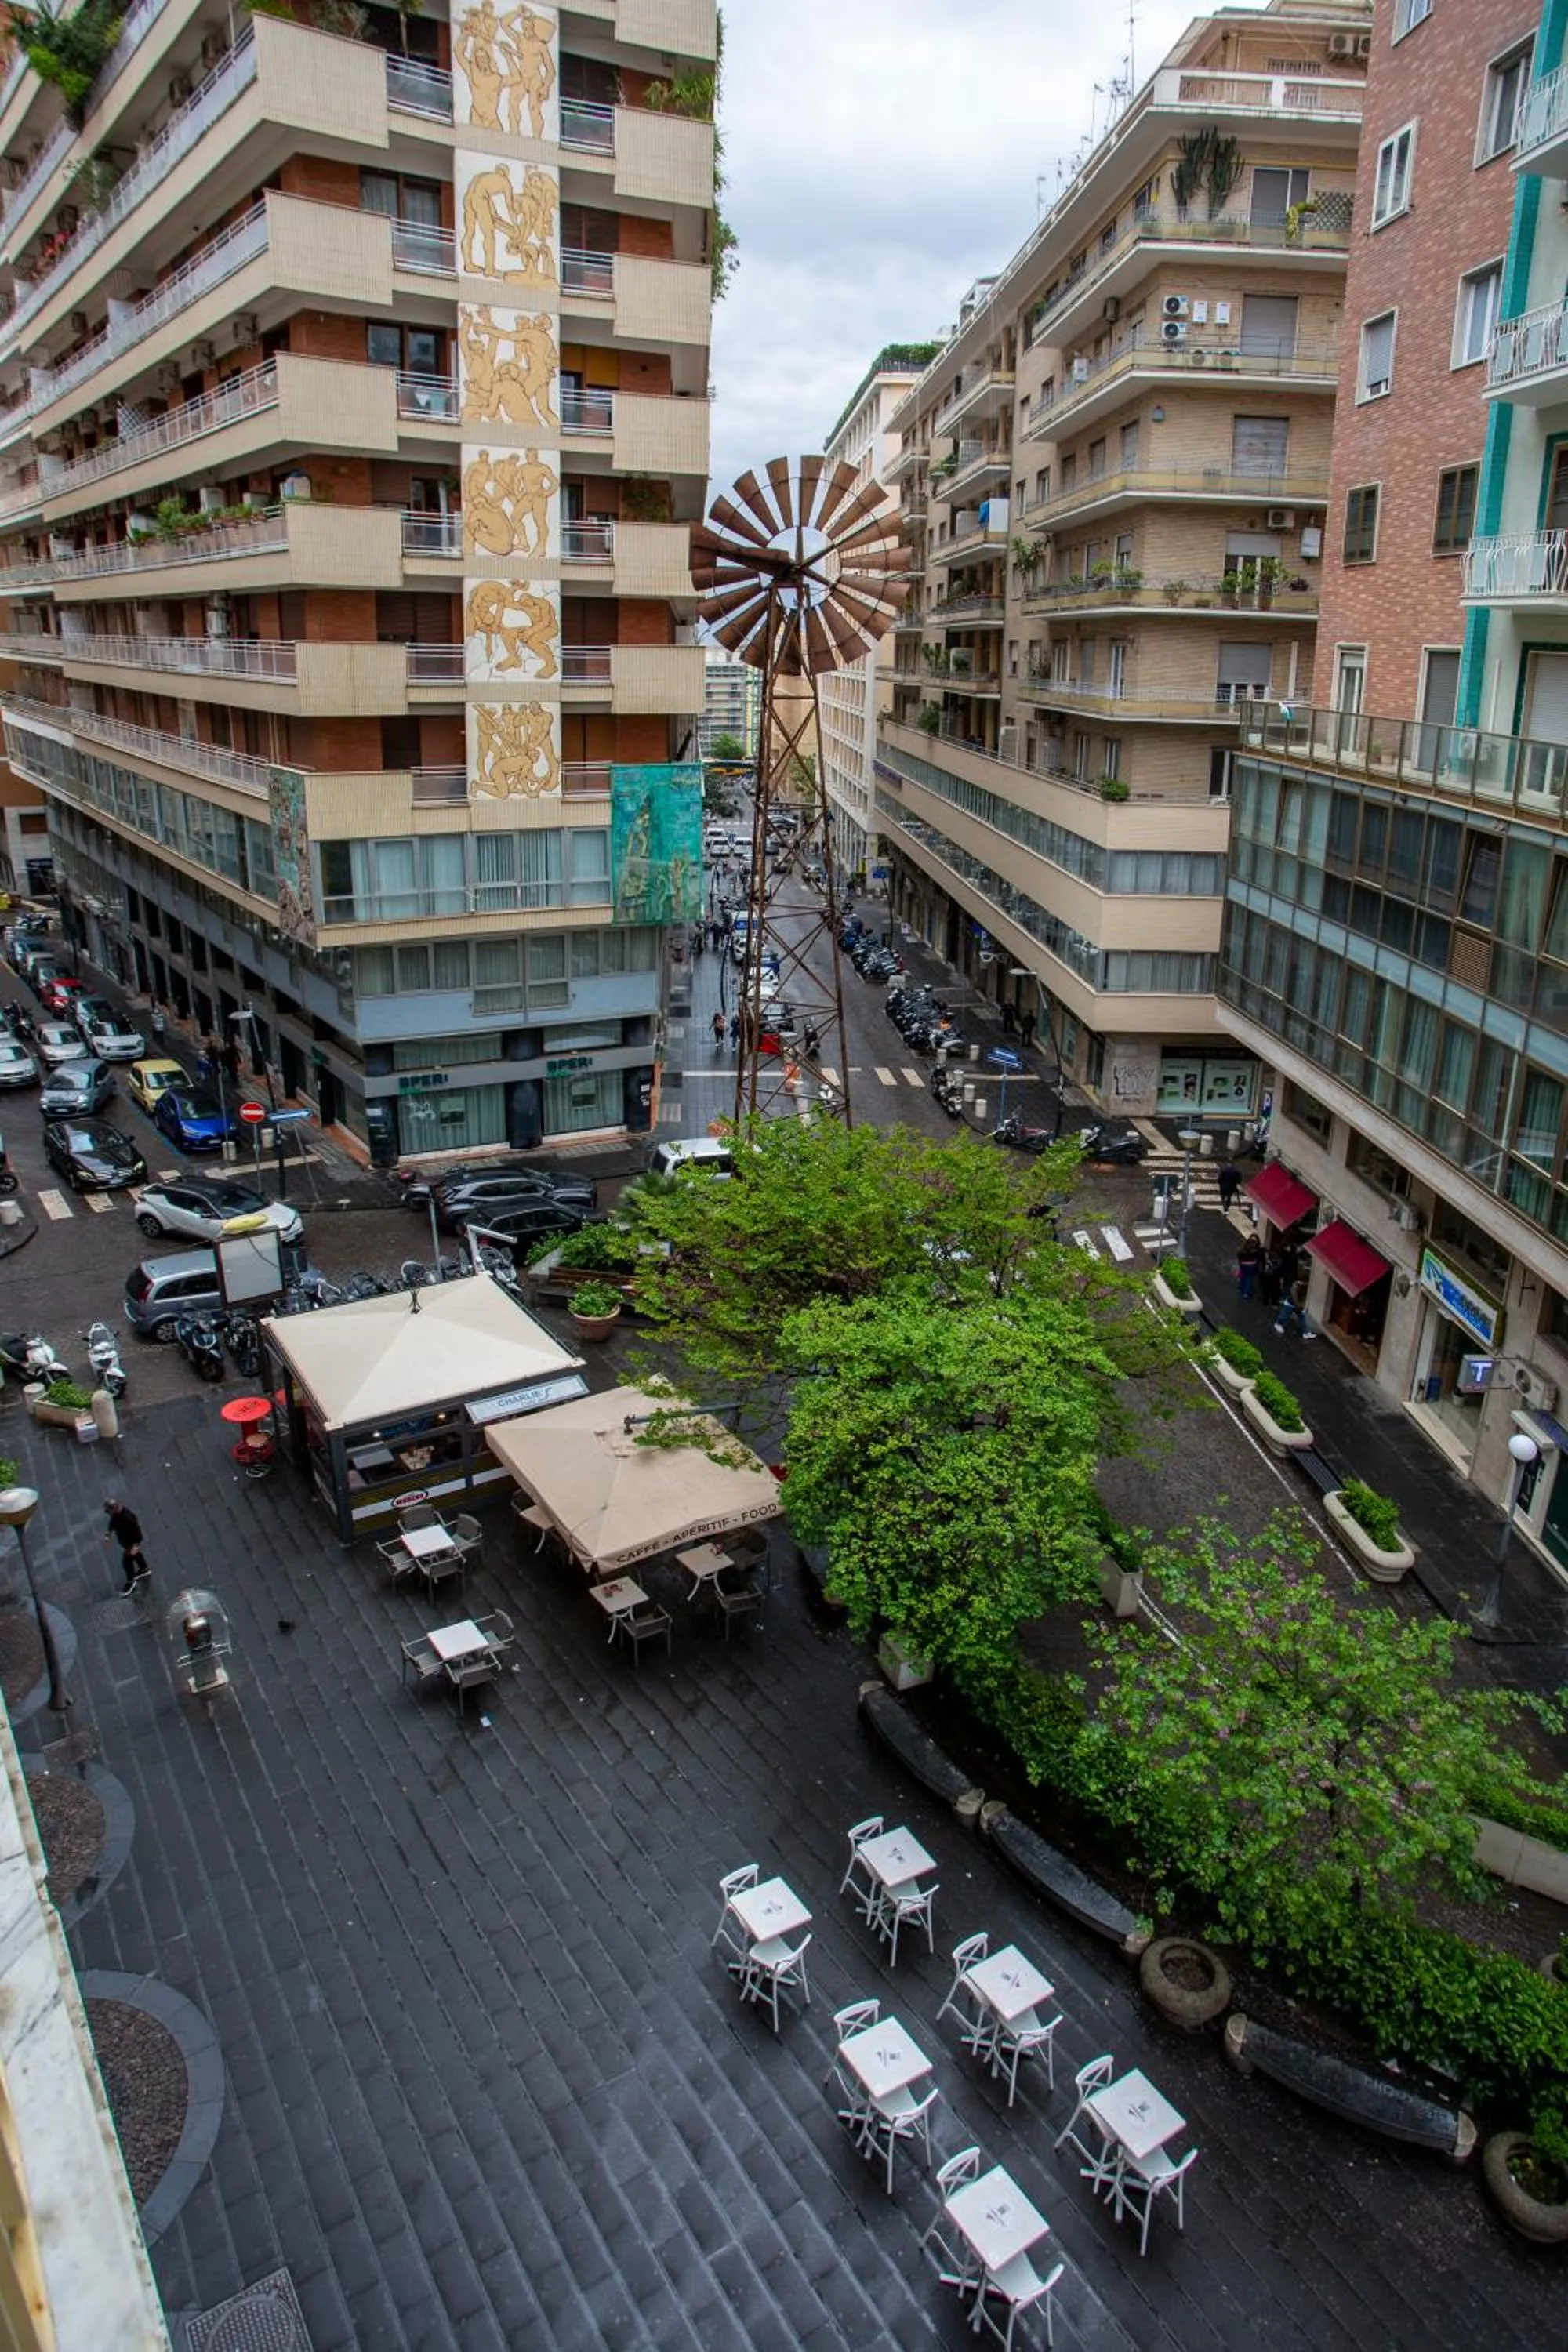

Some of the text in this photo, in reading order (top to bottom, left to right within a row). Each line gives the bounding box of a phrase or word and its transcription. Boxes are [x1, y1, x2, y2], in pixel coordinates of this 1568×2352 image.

[1470, 1363, 1492, 1381] T
[672, 1517, 730, 1543] APERITIF
[741, 1503, 777, 1522] FOOD
